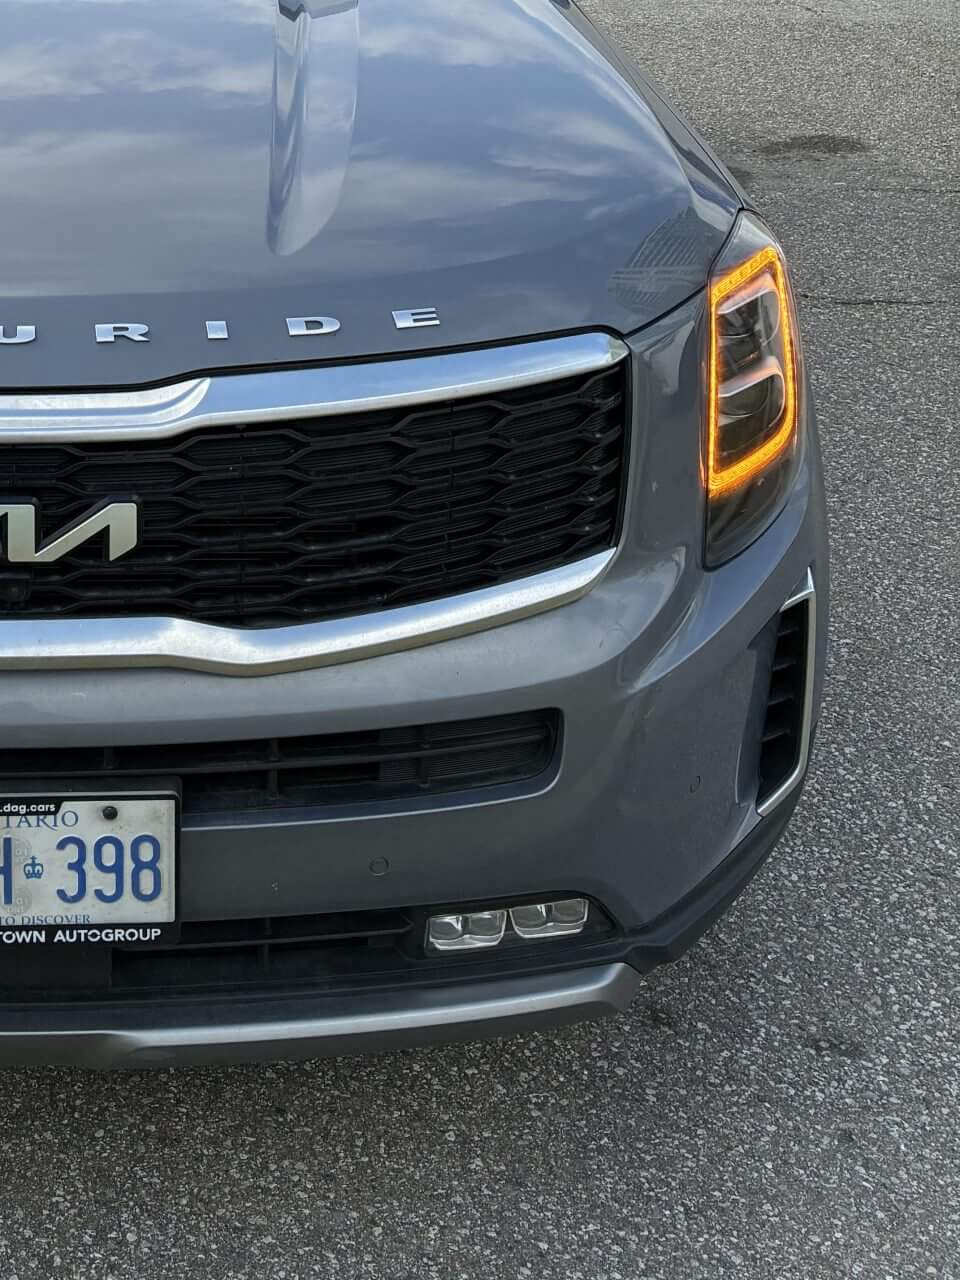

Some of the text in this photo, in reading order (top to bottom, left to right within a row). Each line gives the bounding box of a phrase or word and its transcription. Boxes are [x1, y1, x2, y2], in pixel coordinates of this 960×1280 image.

[55, 834, 162, 904] 398
[21, 914, 91, 926] DISCOVER
[53, 928, 162, 943] AUTOGROUP
